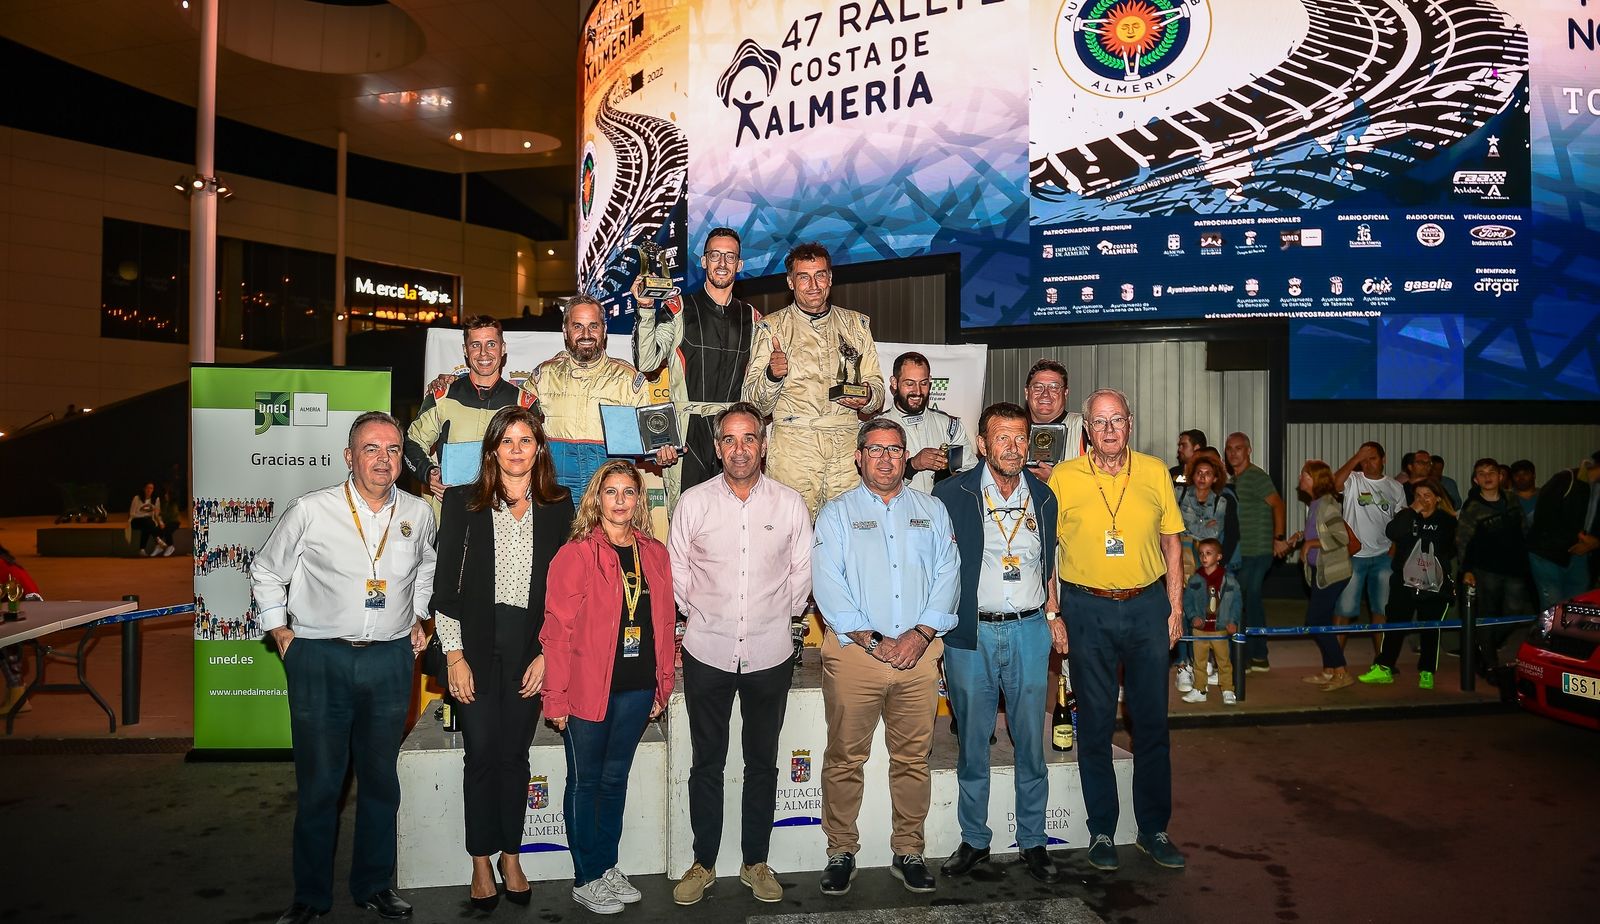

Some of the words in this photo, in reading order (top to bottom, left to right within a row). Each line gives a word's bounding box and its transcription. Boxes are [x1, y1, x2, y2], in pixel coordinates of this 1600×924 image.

[782, 12, 822, 50] 47
[839, 0, 1005, 37] RALL
[790, 42, 881, 87] COSTA
[891, 30, 929, 61] DE
[647, 67, 663, 83] 2022
[1091, 73, 1176, 93] ALMERIA
[765, 63, 933, 139] ALMERÍA
[1105, 190, 1128, 202] Diseño
[1148, 178, 1161, 190] Mar
[1161, 170, 1182, 184] Torres
[1182, 163, 1209, 177] García
[1194, 218, 1255, 227] PATROCINADORES
[1257, 216, 1301, 224] PRINCIPALES
[1043, 226, 1100, 236] PATROCINADORES
[1101, 224, 1132, 232] PREMIUM
[1478, 226, 1507, 239] Ford
[1167, 286, 1208, 294] Ayuntamiento
[1474, 281, 1520, 297] argar
[259, 403, 287, 413] UNED
[251, 453, 304, 466] Gracias
[309, 456, 317, 466] a
[321, 454, 331, 466] ti
[209, 654, 254, 665] uned.es
[209, 688, 288, 696] www.unedalmeria.e
[783, 799, 822, 811] ALMER
